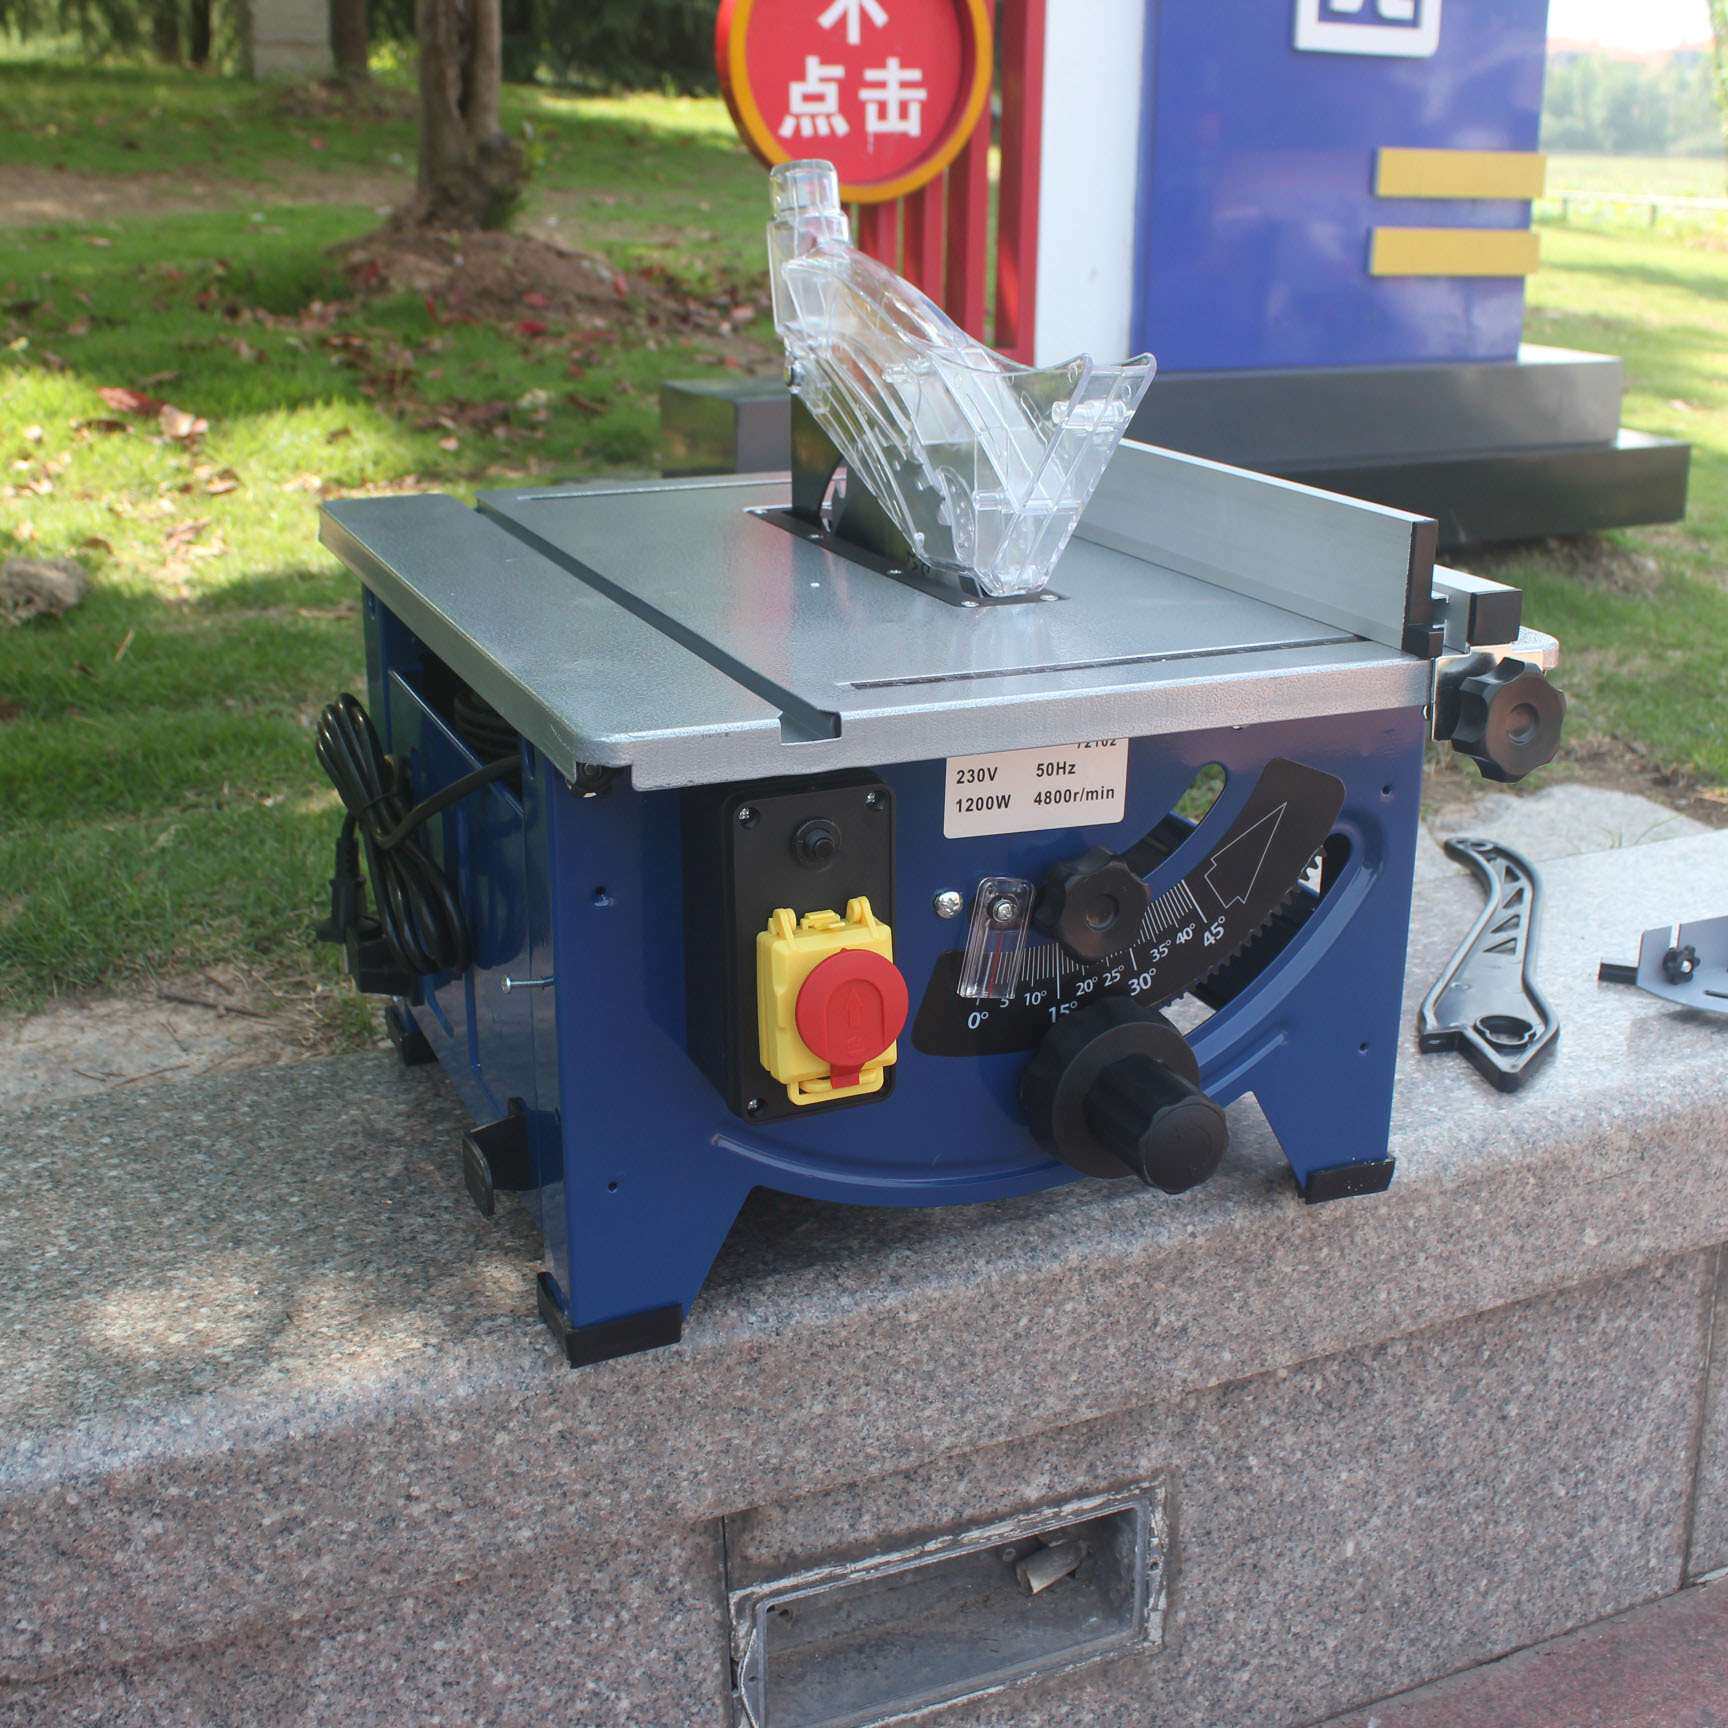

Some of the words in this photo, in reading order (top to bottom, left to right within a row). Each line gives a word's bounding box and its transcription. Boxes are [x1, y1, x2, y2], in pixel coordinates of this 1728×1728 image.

[778, 55, 928, 138] 点击
[956, 767, 998, 784] 230V
[1035, 761, 1077, 777] 50Hz
[955, 794, 1012, 813] 1200W
[1033, 786, 1115, 806] 4800r/min
[1176, 922, 1196, 945] 40°
[1203, 915, 1226, 947] 45°
[1150, 939, 1172, 962] 35°
[1075, 976, 1098, 996] 20°
[1102, 964, 1125, 987] 25°
[1128, 968, 1157, 996] 30°
[1023, 990, 1047, 1006] 10°
[967, 1011, 989, 1030] 0°
